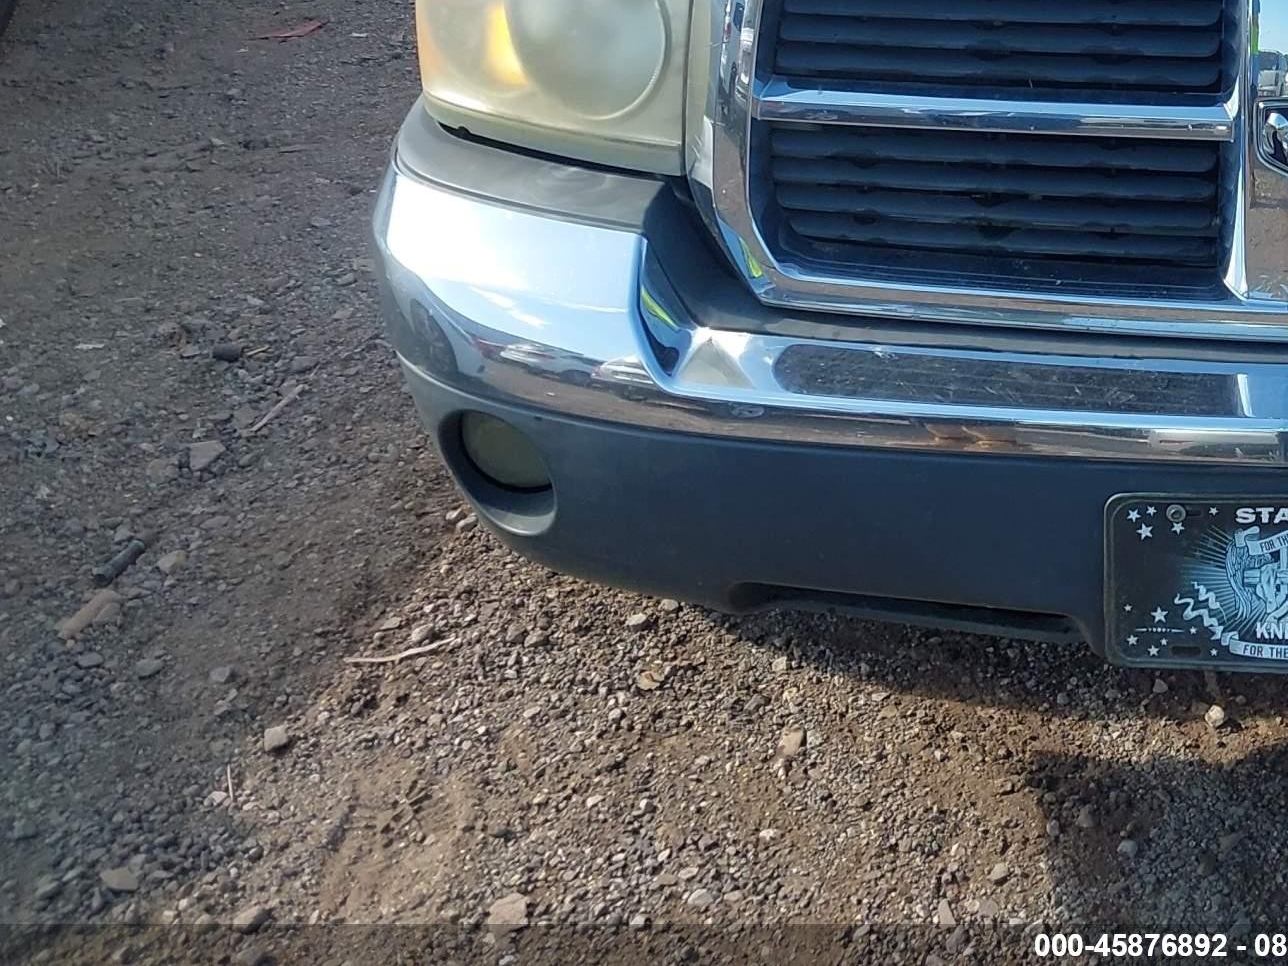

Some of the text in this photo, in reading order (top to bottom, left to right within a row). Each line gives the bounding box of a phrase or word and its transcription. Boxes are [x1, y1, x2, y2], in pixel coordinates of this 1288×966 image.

[1260, 539, 1275, 552] FOR
[1243, 644, 1264, 657] FOR
[1270, 647, 1288, 659] THE
